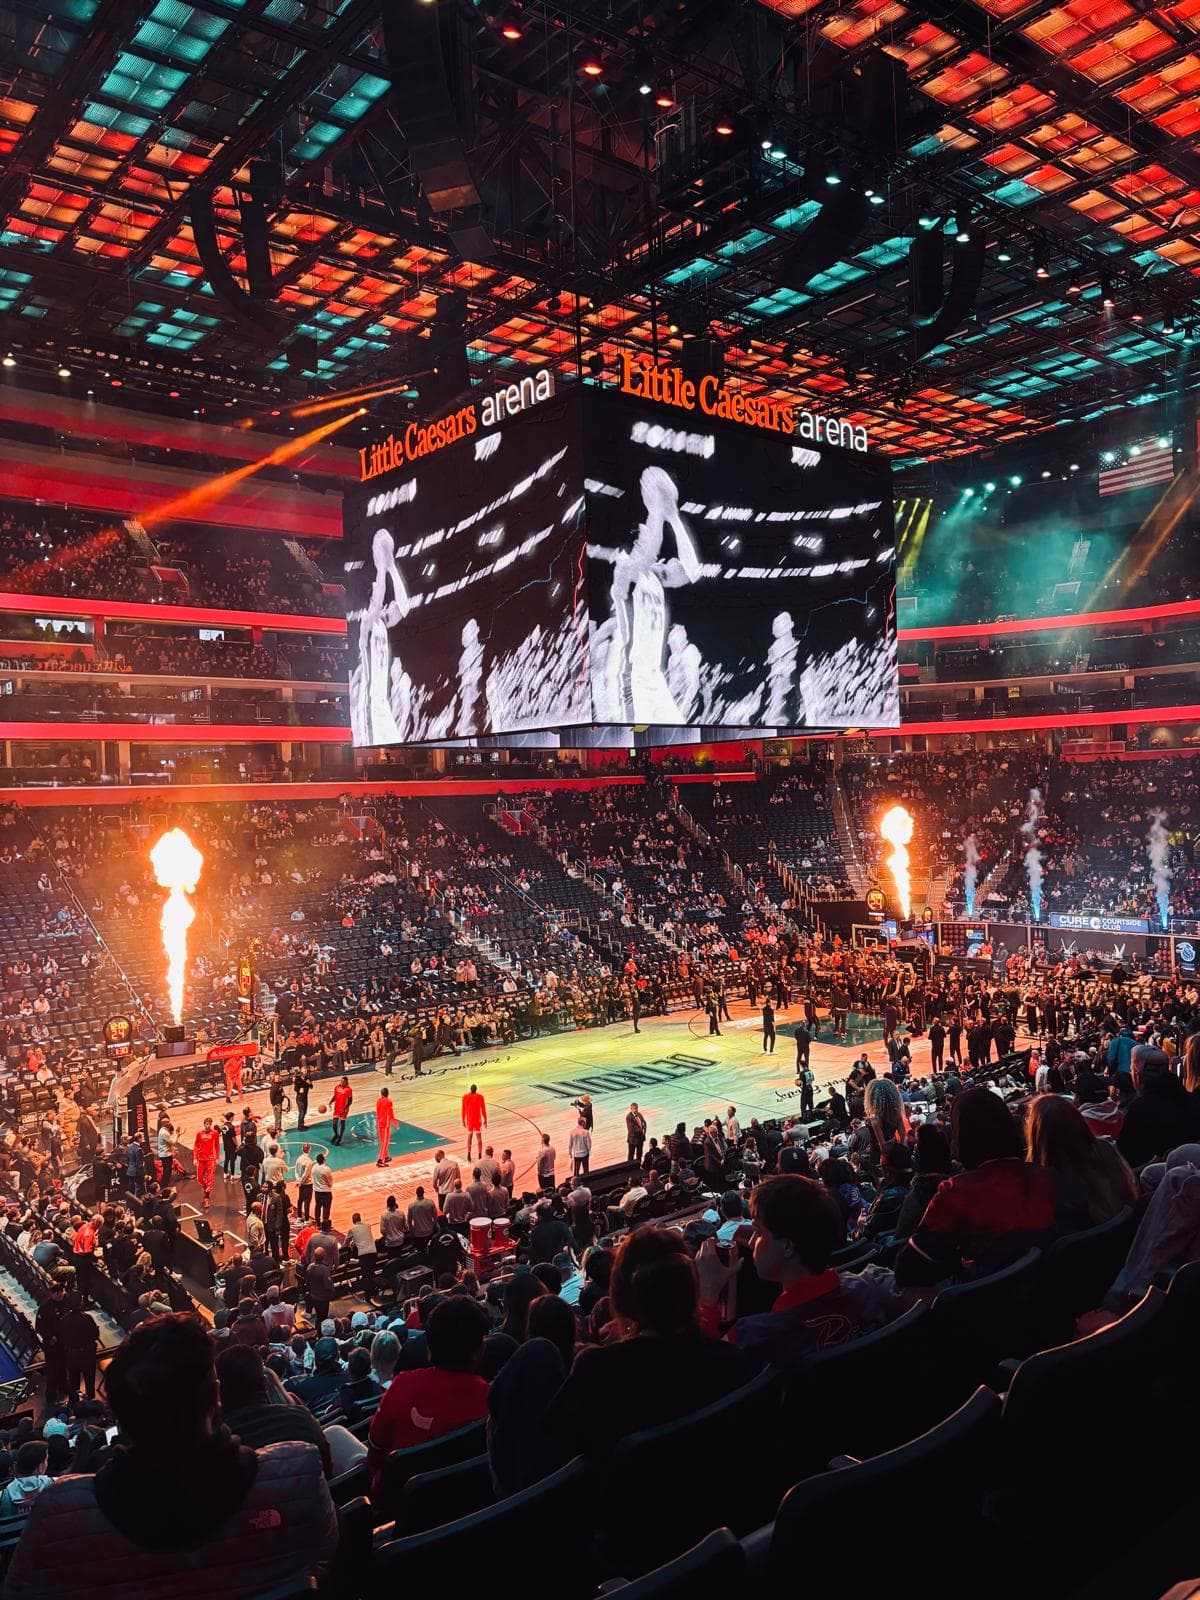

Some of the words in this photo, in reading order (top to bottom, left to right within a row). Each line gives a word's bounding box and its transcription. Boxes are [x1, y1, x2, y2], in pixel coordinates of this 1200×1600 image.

[359, 434, 404, 482] Little
[404, 404, 478, 462] Caesars
[481, 368, 552, 427] arena
[620, 352, 696, 411] Little
[699, 374, 795, 434] Caesars
[799, 410, 868, 453] arena
[1059, 915, 1089, 925] CURE
[1101, 918, 1142, 927] COURTSIDE
[528, 1053, 722, 1099] DETROIT
